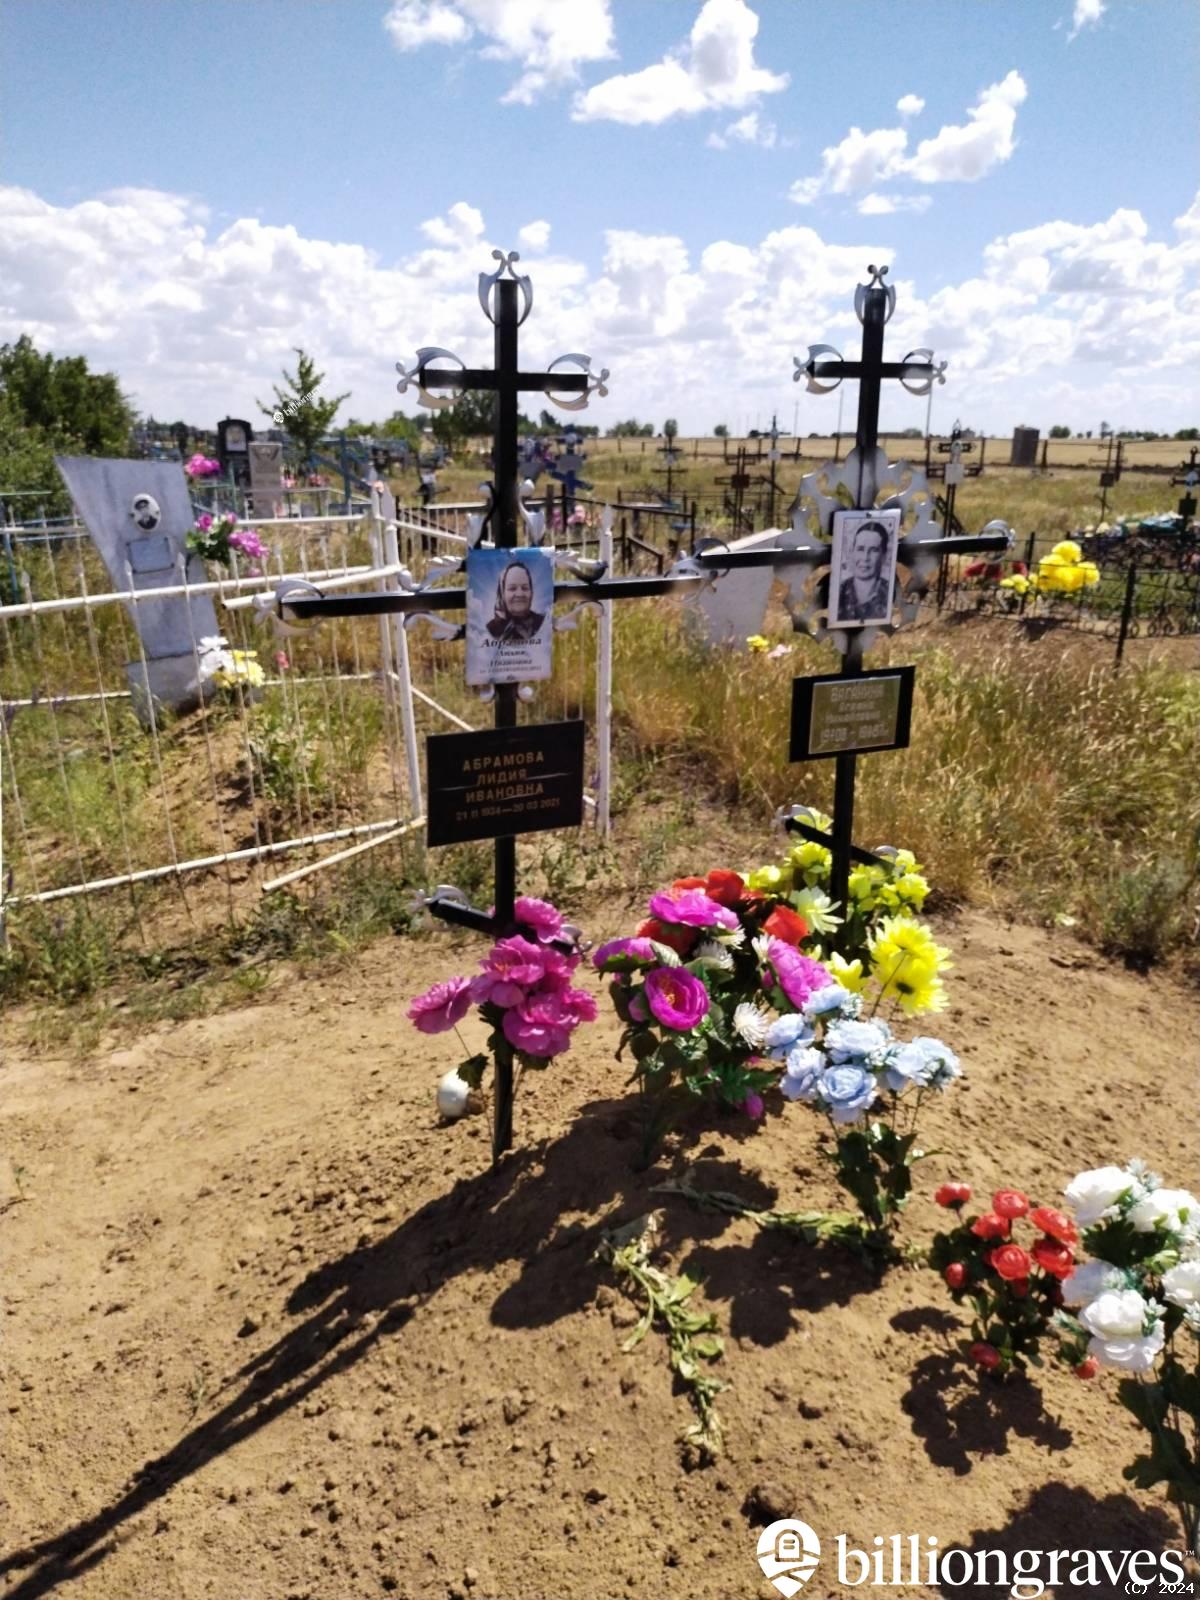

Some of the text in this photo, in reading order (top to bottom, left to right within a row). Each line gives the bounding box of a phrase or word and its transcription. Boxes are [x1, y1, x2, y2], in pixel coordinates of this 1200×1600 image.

[462, 751, 545, 772] АБРАМОВА
[476, 768, 528, 786] ЛИДИЯ
[465, 782, 545, 803] ИВАНОВНА
